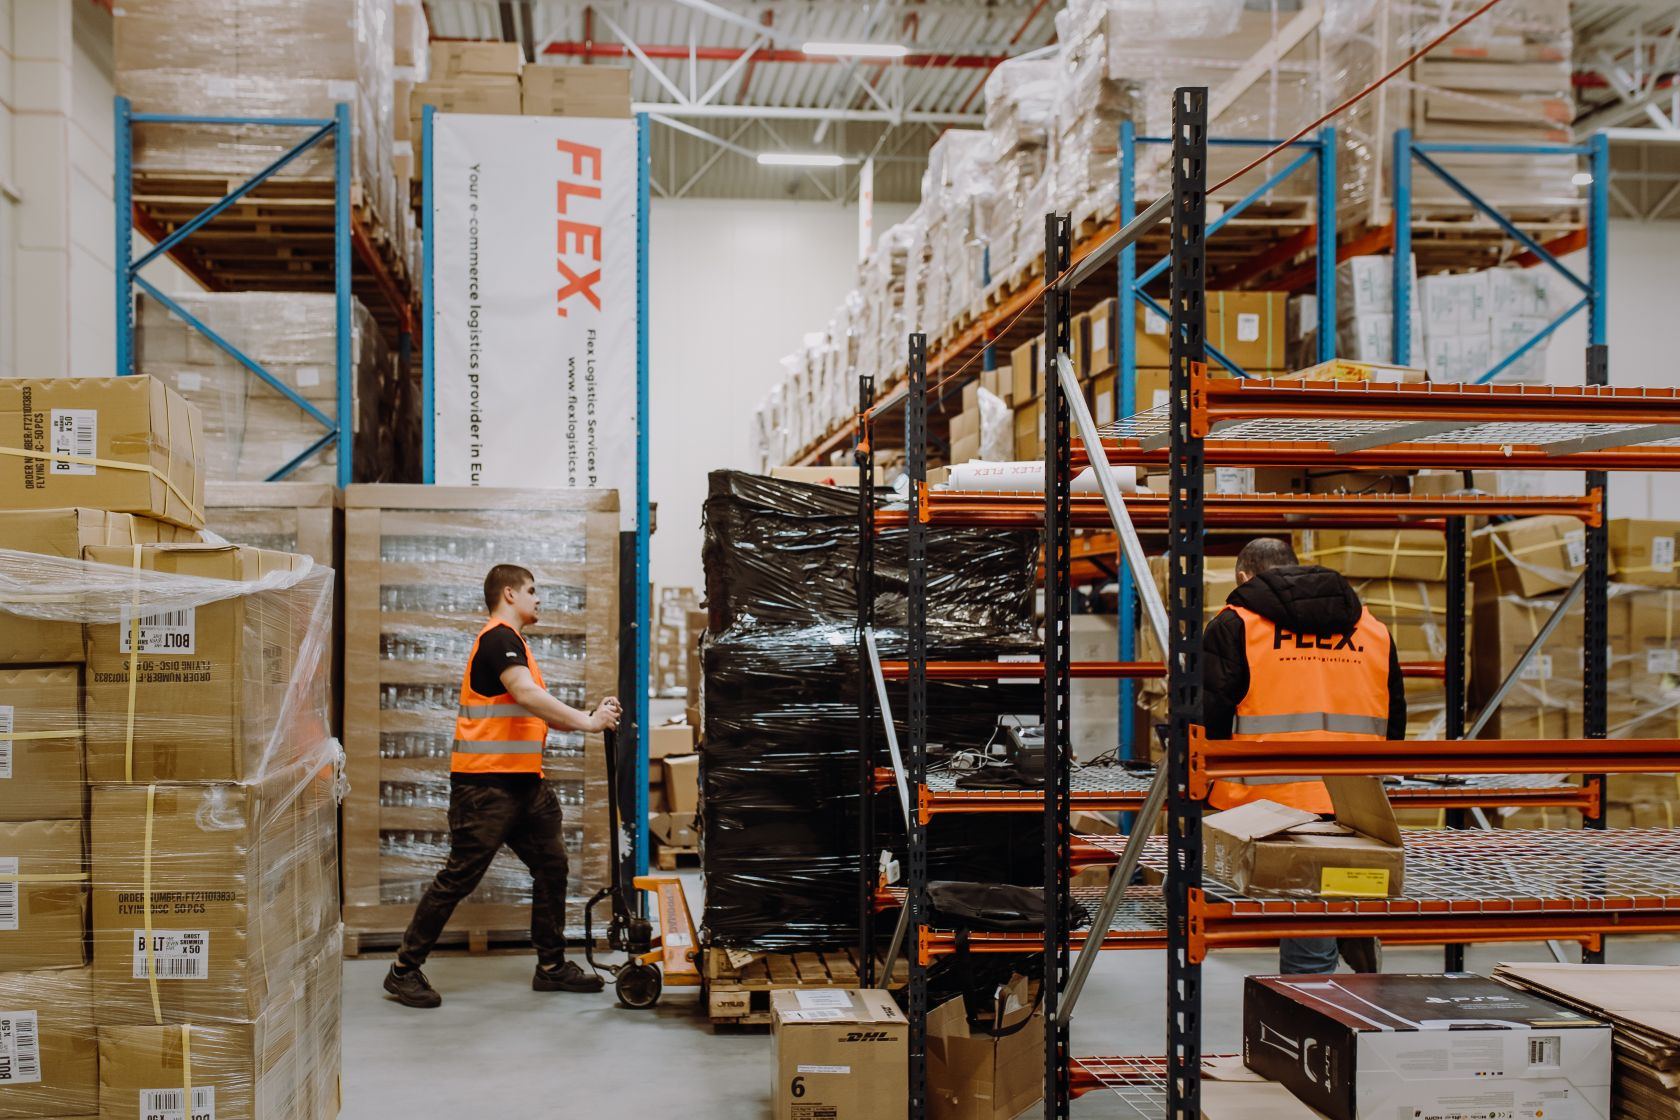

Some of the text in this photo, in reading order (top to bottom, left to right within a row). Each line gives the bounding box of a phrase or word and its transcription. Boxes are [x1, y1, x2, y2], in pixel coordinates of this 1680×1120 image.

[468, 163, 481, 199] Your
[557, 138, 602, 318] FLEX.
[468, 203, 480, 301] e-commerce
[467, 304, 482, 370] logistics
[586, 328, 597, 356] Flex
[585, 359, 598, 416] Logistics
[467, 373, 483, 440] provider
[34, 412, 43, 429] PCS
[65, 416, 72, 426] 50
[23, 386, 34, 489] ORDER NMBER:FT211013833
[35, 430, 43, 440] 50
[470, 443, 484, 459] in
[587, 418, 598, 471] Services
[57, 447, 70, 470] BT
[36, 462, 45, 489] FLYING
[163, 633, 190, 648] BOLT
[123, 660, 141, 671] PS
[142, 660, 154, 671] 50
[183, 672, 211, 682] ORDER
[118, 893, 145, 903] ORDER
[174, 903, 186, 914] 50
[187, 903, 206, 914] PCS
[138, 936, 165, 952] BLT
[189, 945, 201, 954] 50
[1, 1019, 11, 1031] 50
[846, 1031, 890, 1043] DHL
[790, 1076, 806, 1098] 6
